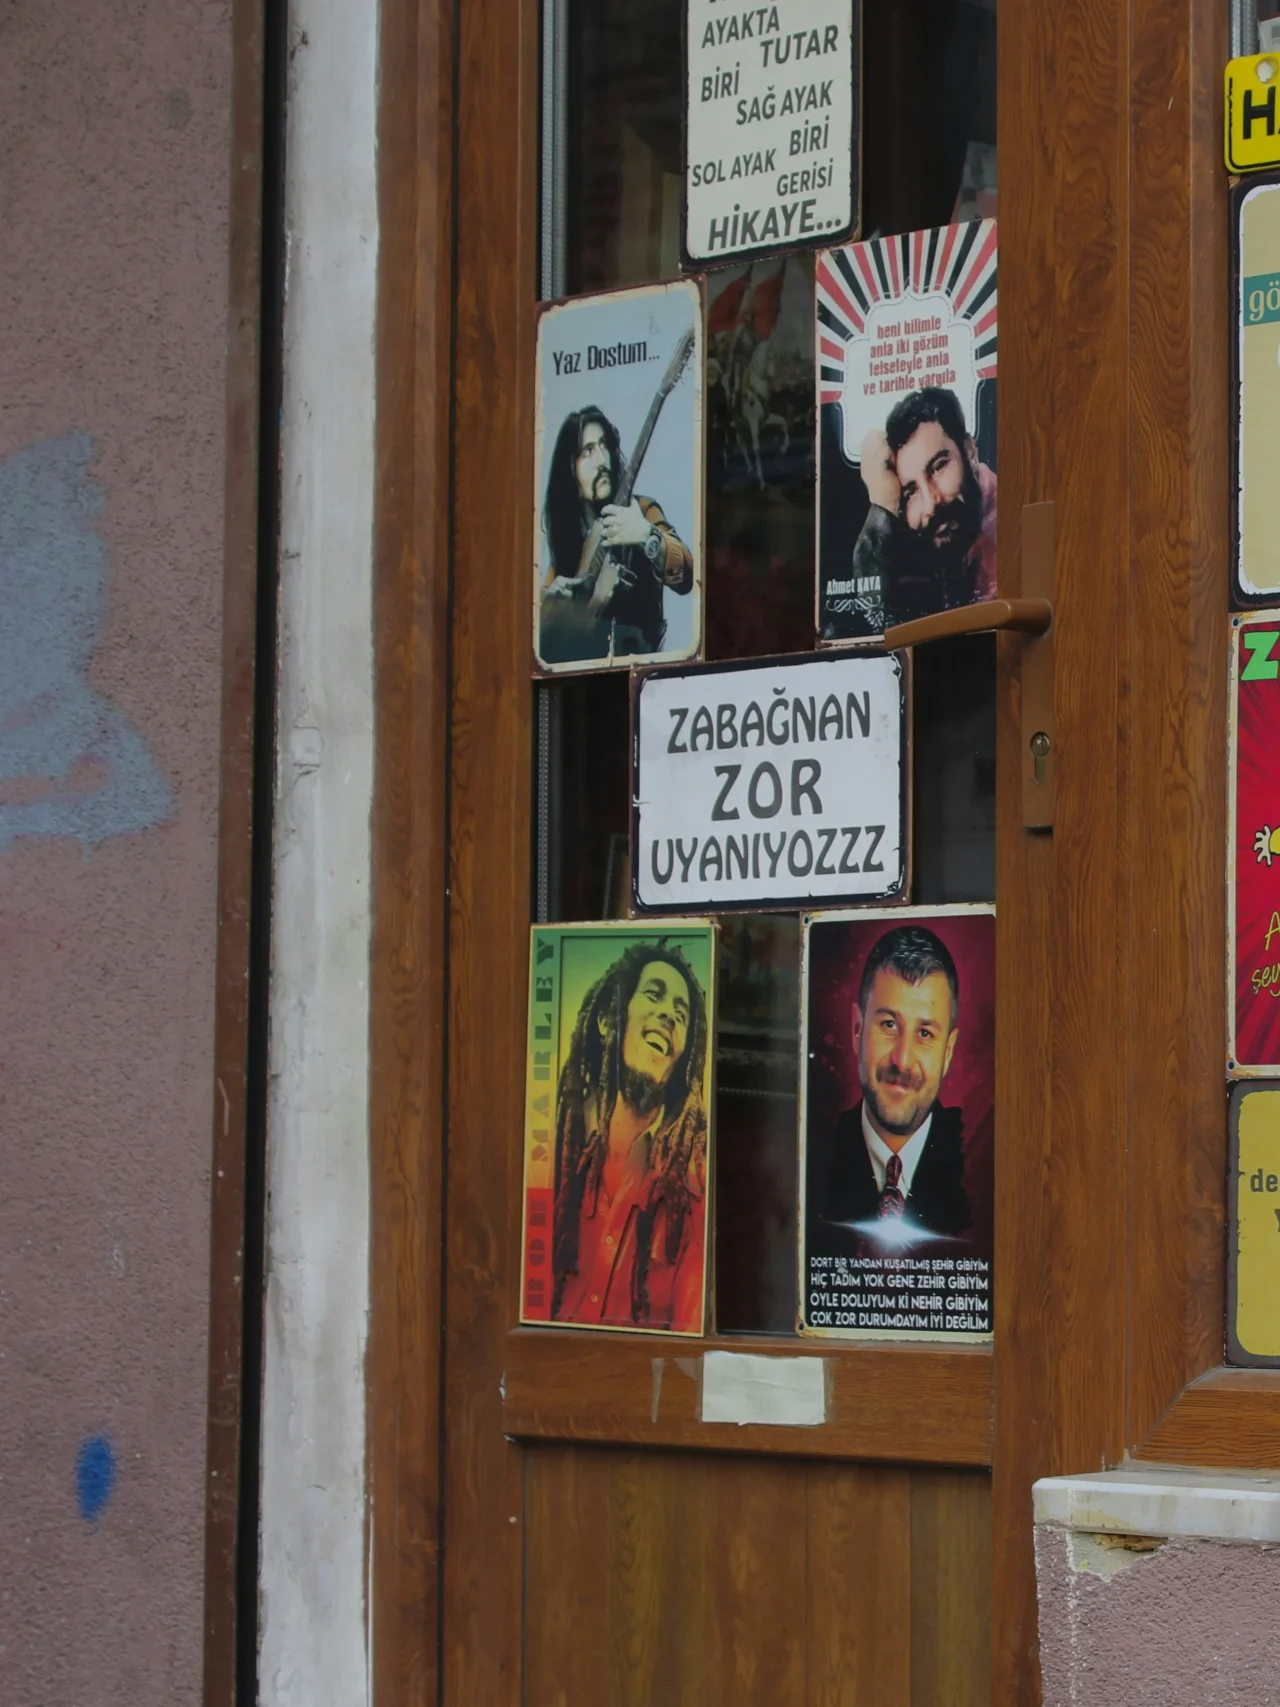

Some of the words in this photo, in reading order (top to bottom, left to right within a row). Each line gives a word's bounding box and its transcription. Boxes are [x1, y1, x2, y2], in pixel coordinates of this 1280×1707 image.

[701, 6, 780, 49] AYAKTA
[760, 25, 839, 68] TUTAR
[701, 61, 740, 102] BİRİ
[735, 84, 777, 126] SAĞ
[780, 79, 834, 117] AYAK
[789, 115, 829, 156] BİRİ
[691, 159, 727, 188] SOL
[730, 148, 777, 180] AYAK
[776, 157, 834, 197] GERİSİ
[708, 198, 842, 252] HİKAYE...
[870, 342, 893, 359] anla
[896, 339, 910, 355] iki
[913, 333, 948, 355] gözüm
[877, 322, 900, 339] beni
[904, 316, 941, 335] bilimle
[551, 346, 582, 376] Yaz
[587, 340, 660, 371] Dostum...
[869, 355, 923, 376] felsefeyle
[926, 351, 950, 368] anla
[863, 381, 876, 395] ve
[880, 374, 915, 393] tarihle
[826, 578, 855, 595] Ahmet
[857, 575, 881, 593] KAYA
[667, 687, 871, 755] ZABAĞNAN
[711, 758, 823, 821] ZOR
[651, 824, 886, 885] UYANIYOZZZ
[810, 1270, 828, 1288] HİÇ
[863, 1273, 885, 1288] YOK
[887, 1274, 916, 1288] GENE
[917, 1272, 946, 1288] ZEHİR
[948, 1273, 988, 1290] GİBİYİM
[849, 1257, 882, 1269] YANDAN
[931, 1257, 954, 1272] ŞEHİR
[956, 1258, 988, 1271] GİBİYİM
[810, 1289, 839, 1307] ÖYLE
[841, 1292, 896, 1308] DOLUYUM
[898, 1291, 909, 1309] Kİ
[911, 1292, 943, 1310] NEHİR
[946, 1293, 988, 1311] GİBİYİM
[810, 1311, 833, 1327] ÇOK
[835, 1311, 857, 1326] ZOR
[859, 1312, 928, 1328] DURUMDAYIM
[930, 1312, 943, 1328] İYİ
[946, 1312, 988, 1330] DEĞİLİM
